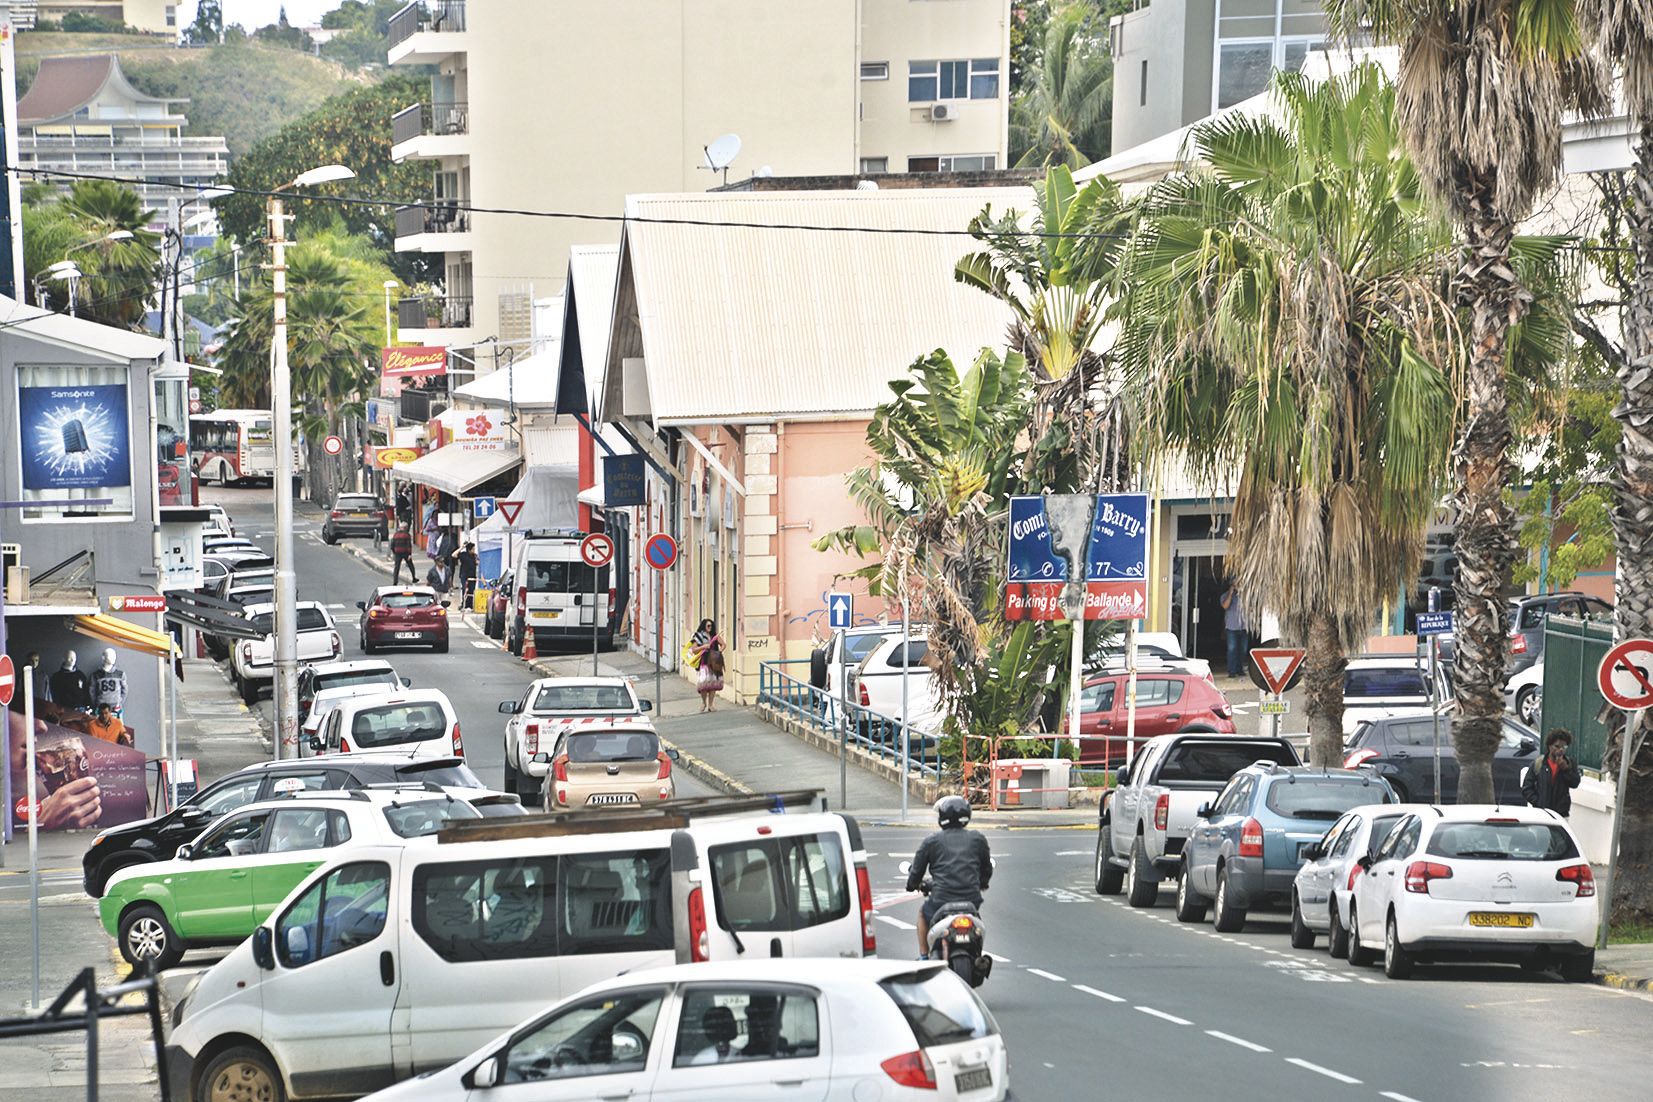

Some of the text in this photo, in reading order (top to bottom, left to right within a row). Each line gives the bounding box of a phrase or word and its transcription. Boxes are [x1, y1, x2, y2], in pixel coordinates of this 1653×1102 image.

[51, 390, 95, 399] Samsonite
[126, 599, 164, 609] Malongo
[1008, 594, 1047, 611] Parking
[1087, 592, 1132, 608] Ballande
[100, 680, 116, 692] 69
[1471, 913, 1531, 927] 338202 NC
